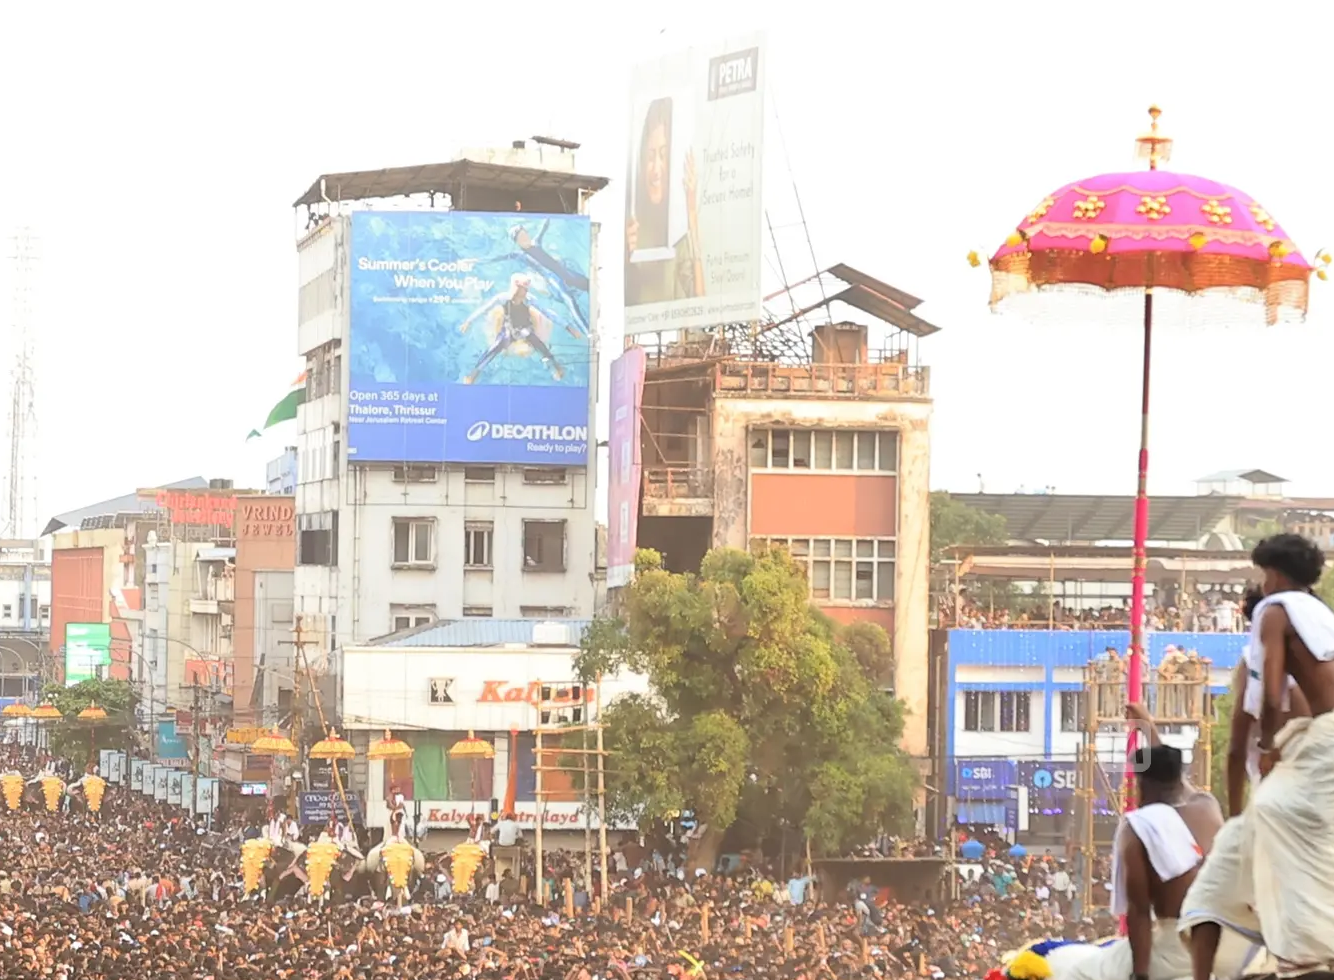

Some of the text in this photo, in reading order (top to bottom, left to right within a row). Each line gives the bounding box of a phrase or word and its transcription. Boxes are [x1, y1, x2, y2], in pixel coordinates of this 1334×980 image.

[719, 57, 753, 85] PETRA
[358, 257, 475, 273] Summer's Cooler
[394, 275, 495, 292] When You Play
[349, 390, 438, 404] Open 365 days at
[349, 404, 436, 417] Thalore, Thrissur
[491, 423, 587, 441] DECATHLON
[526, 442, 587, 454] Ready to play?
[242, 504, 294, 521] VRIND
[242, 524, 294, 537] JEWEL
[972, 766, 992, 779] SBI
